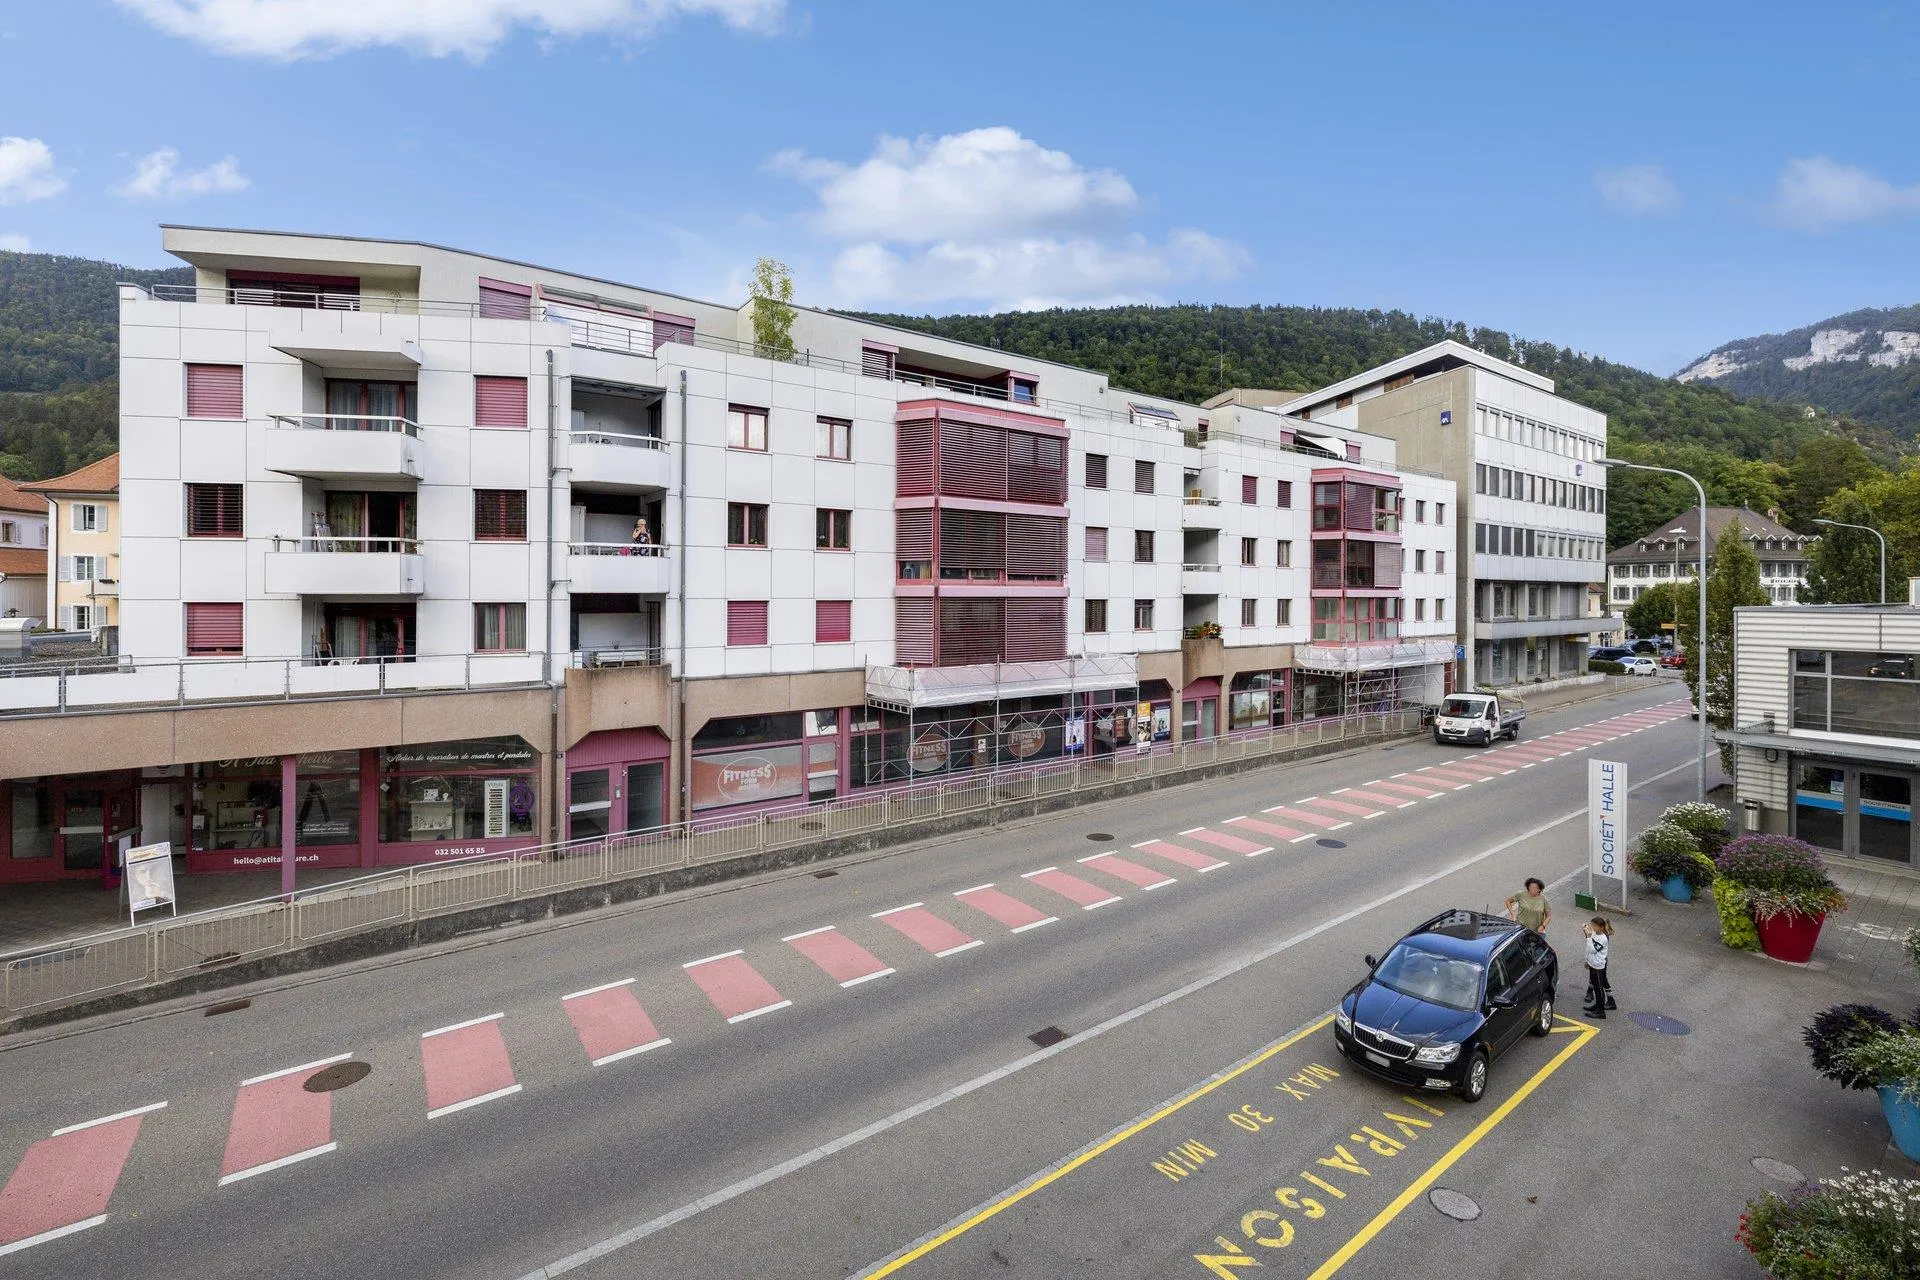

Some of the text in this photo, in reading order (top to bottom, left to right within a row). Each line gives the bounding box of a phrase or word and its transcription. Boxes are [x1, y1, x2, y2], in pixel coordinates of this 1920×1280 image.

[415, 753, 424, 761] de
[426, 752, 459, 763] réparation
[460, 752, 470, 760] de
[470, 751, 495, 760] montres
[503, 750, 532, 761] pendules
[723, 763, 772, 785] FITNESS
[434, 848, 449, 856] 032
[450, 847, 464, 855] 501
[465, 847, 475, 855] 65
[1151, 1062, 1341, 1182] MAX 30 MIN
[1192, 1093, 1446, 1280] IVRAISON
